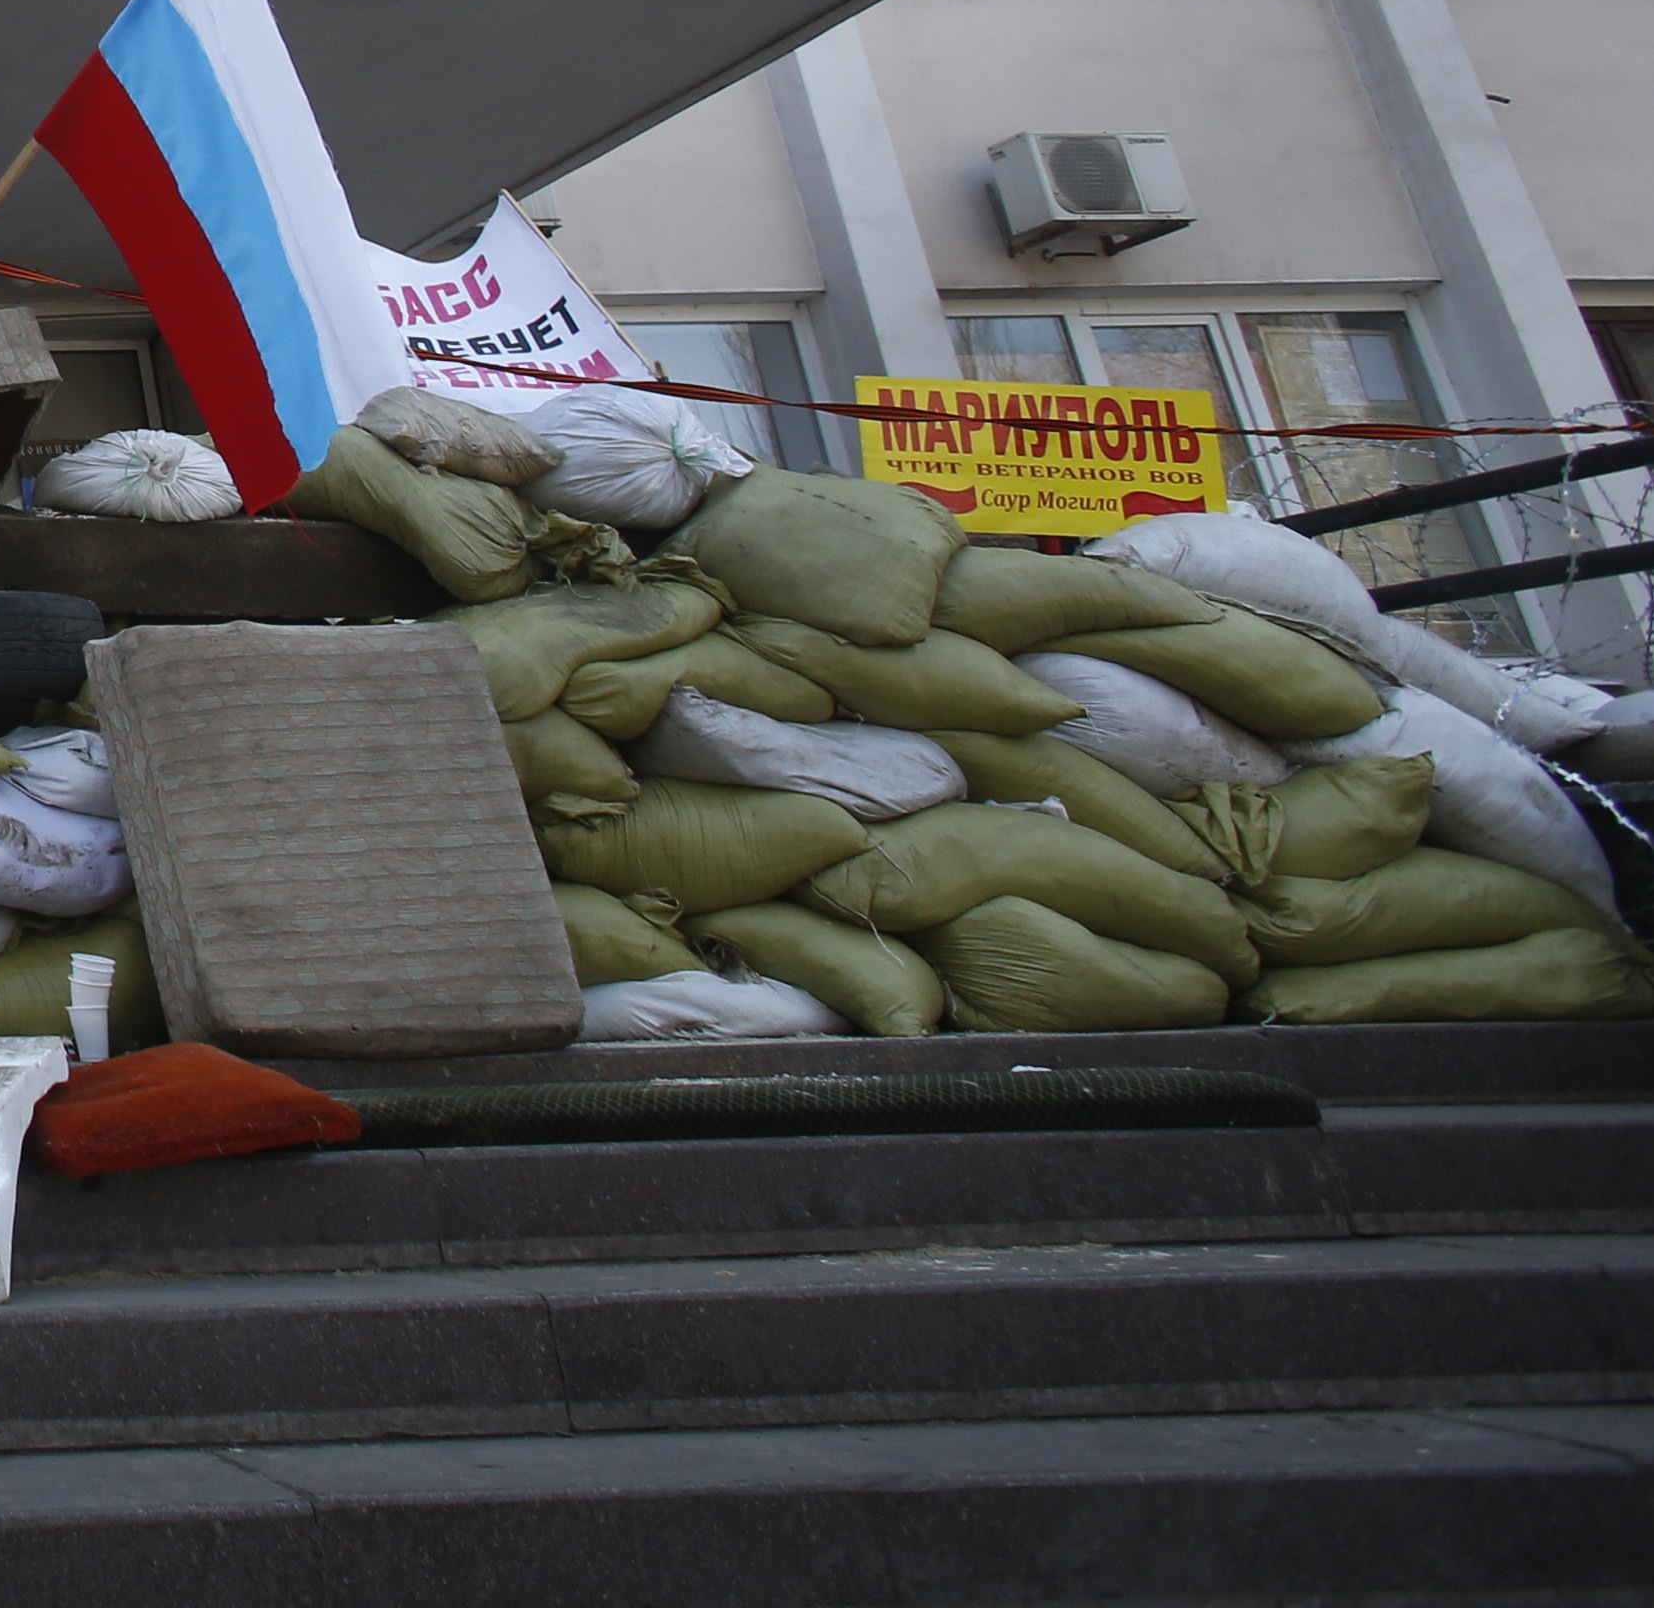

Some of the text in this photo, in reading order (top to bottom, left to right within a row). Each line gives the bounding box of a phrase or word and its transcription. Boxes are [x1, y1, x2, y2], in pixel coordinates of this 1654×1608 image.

[877, 387, 1201, 465] МАРИУПОЛЬ
[886, 458, 1204, 485] ЧТИТ ВЕТЕРАНОВ ВОВ
[980, 488, 1119, 514] Саур Могила
